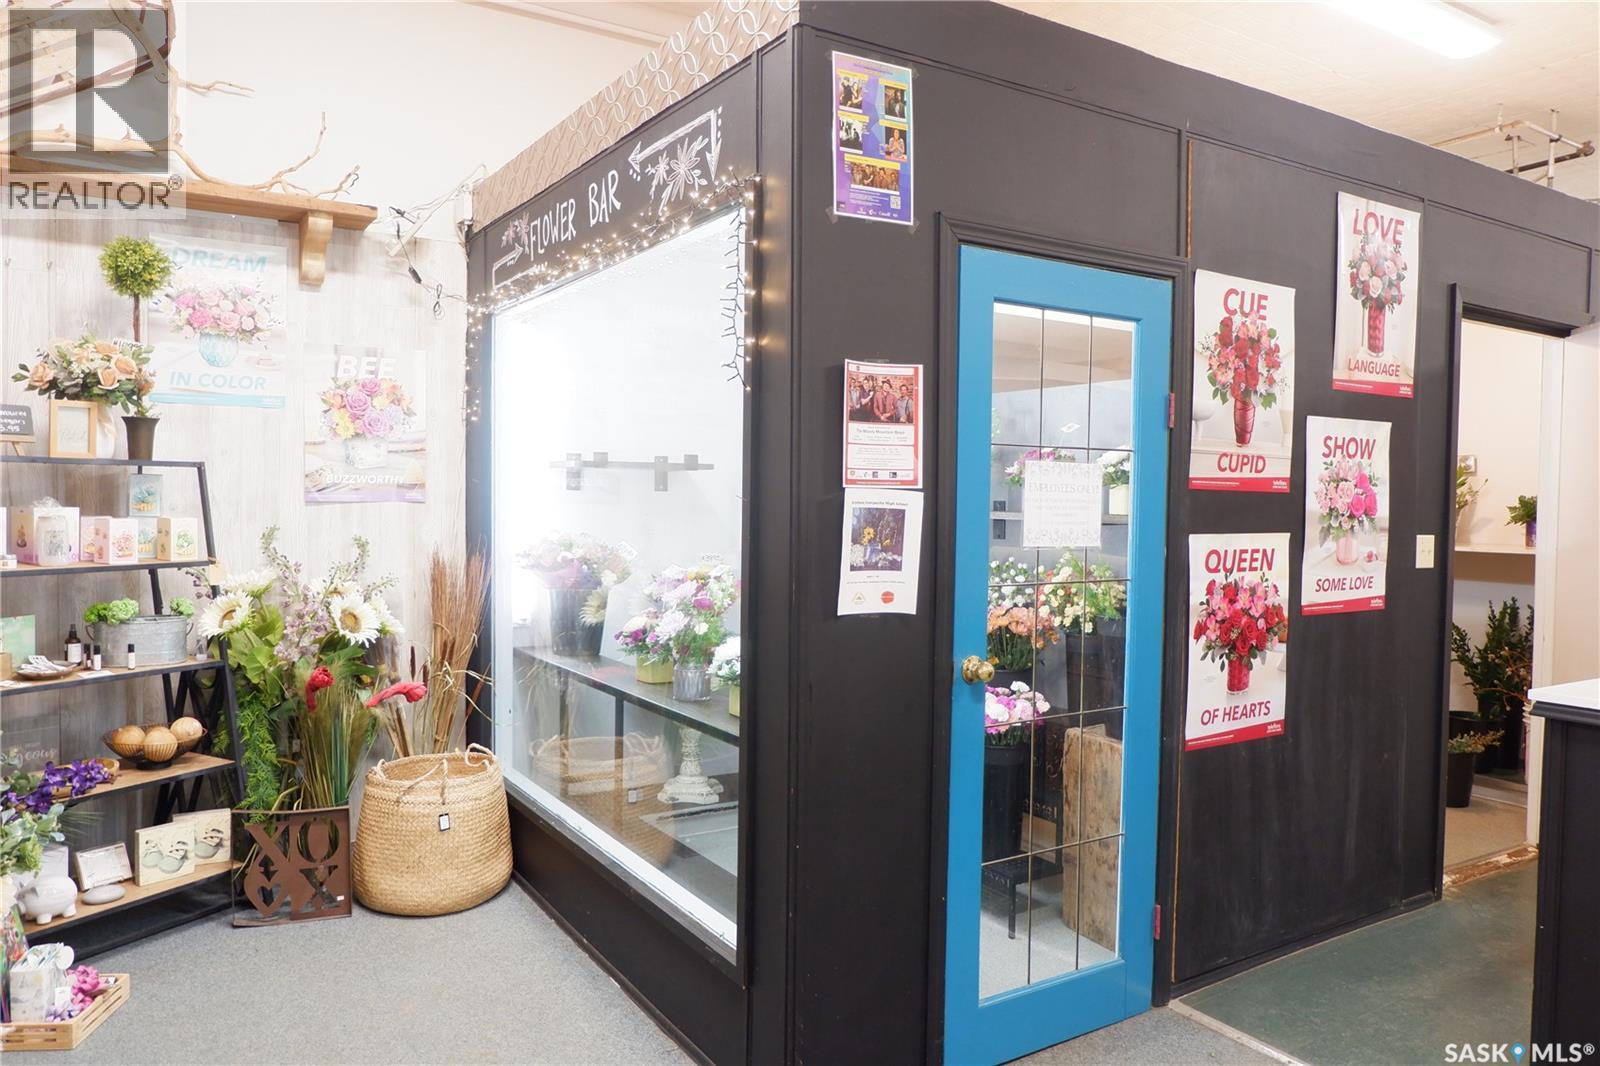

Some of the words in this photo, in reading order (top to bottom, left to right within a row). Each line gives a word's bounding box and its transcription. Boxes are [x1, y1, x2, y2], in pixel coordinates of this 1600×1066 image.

[529, 198, 577, 261] FLOWER
[588, 170, 621, 227] BAR
[1352, 208, 1405, 244] LOVE
[171, 246, 268, 273] DREAM
[1223, 288, 1268, 320] CUE
[336, 355, 398, 379] BEE
[1348, 358, 1401, 378] LANGUAGE
[170, 370, 194, 388] IN
[199, 371, 267, 391] COLOR
[1322, 434, 1376, 460] SHOW
[1217, 452, 1266, 474] CUPID
[1205, 548, 1275, 574] QUEEN
[1315, 577, 1346, 593] SOME
[1349, 575, 1374, 591] LOVE
[1200, 708, 1220, 726] OF
[1223, 700, 1271, 724] HEARTS
